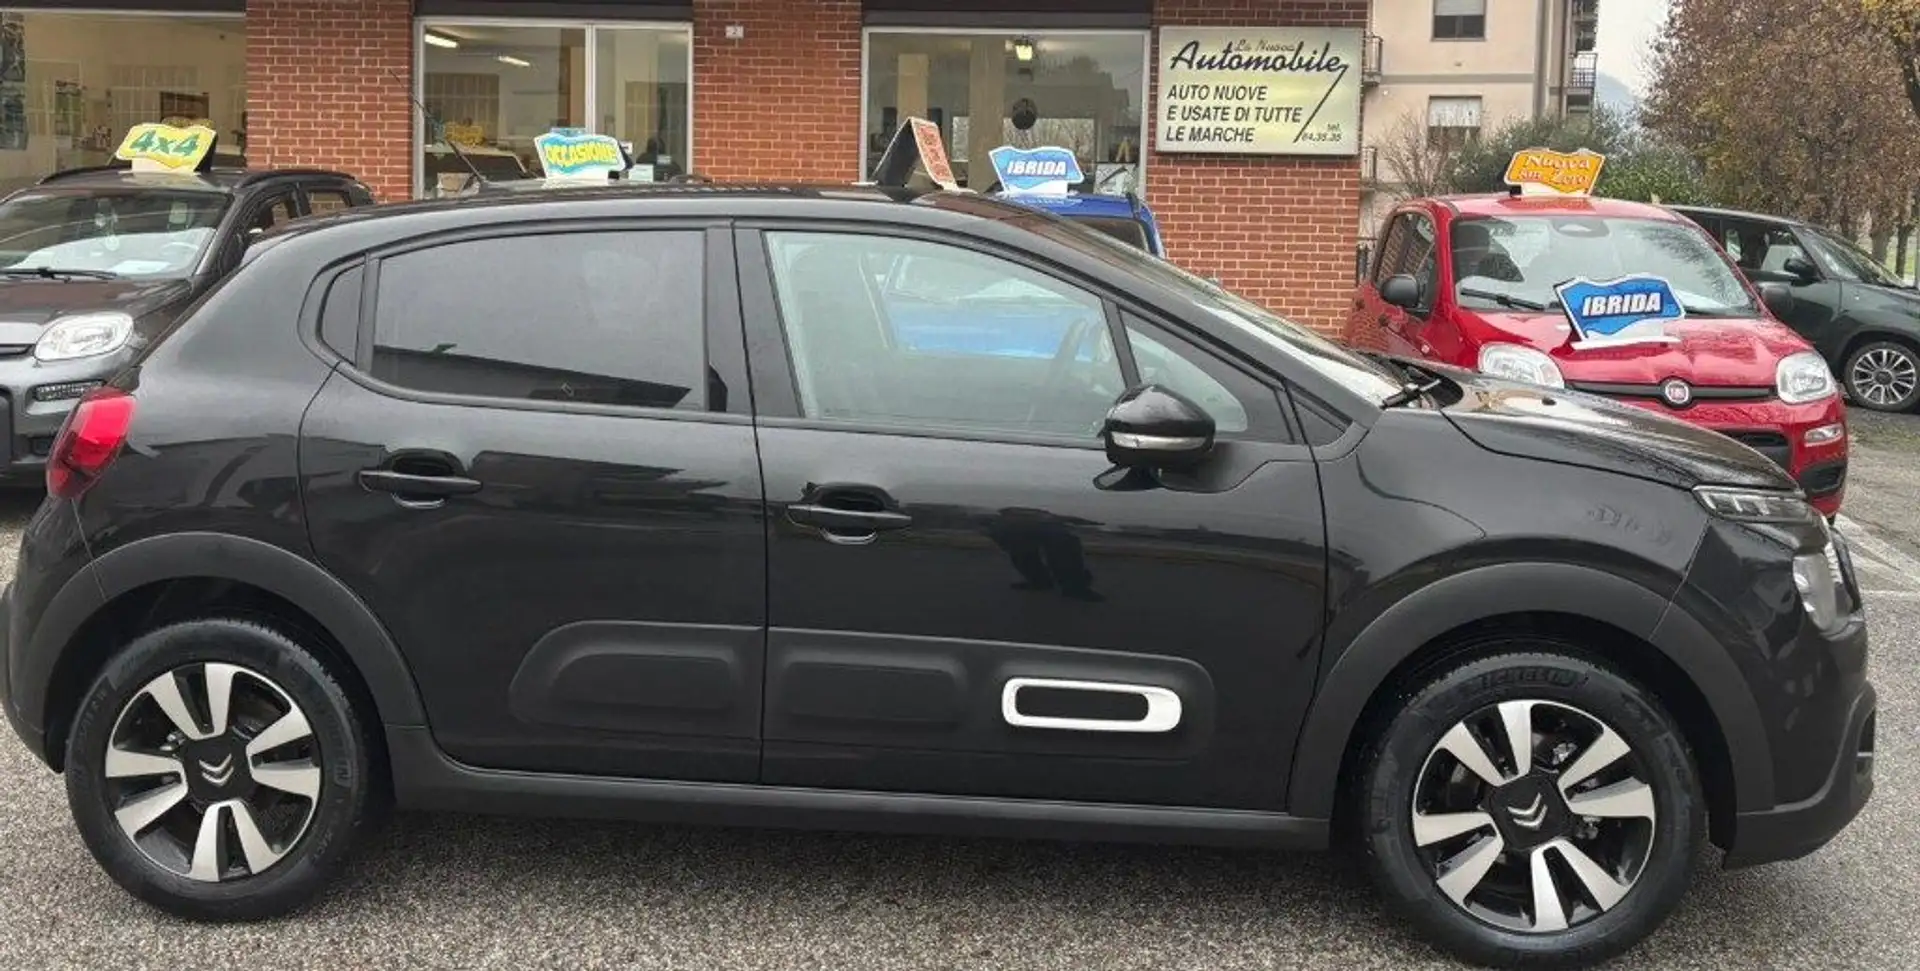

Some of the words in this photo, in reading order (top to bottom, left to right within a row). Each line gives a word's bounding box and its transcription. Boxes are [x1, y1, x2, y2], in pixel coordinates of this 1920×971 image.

[1170, 40, 1349, 72] Automobile
[1167, 85, 1210, 100] AUTO
[1213, 85, 1268, 100] NUOVE
[1167, 106, 1178, 121] E
[1181, 106, 1231, 121] USATE
[1234, 107, 1250, 121] DI
[1255, 107, 1303, 122] TUTTE
[1166, 126, 1186, 141] LE
[1189, 127, 1255, 142] MARCHE
[129, 130, 200, 156] 4x4
[1007, 160, 1067, 176] IBRIDA
[1524, 154, 1590, 170] Nuova
[1582, 292, 1661, 317] IBRIDA
